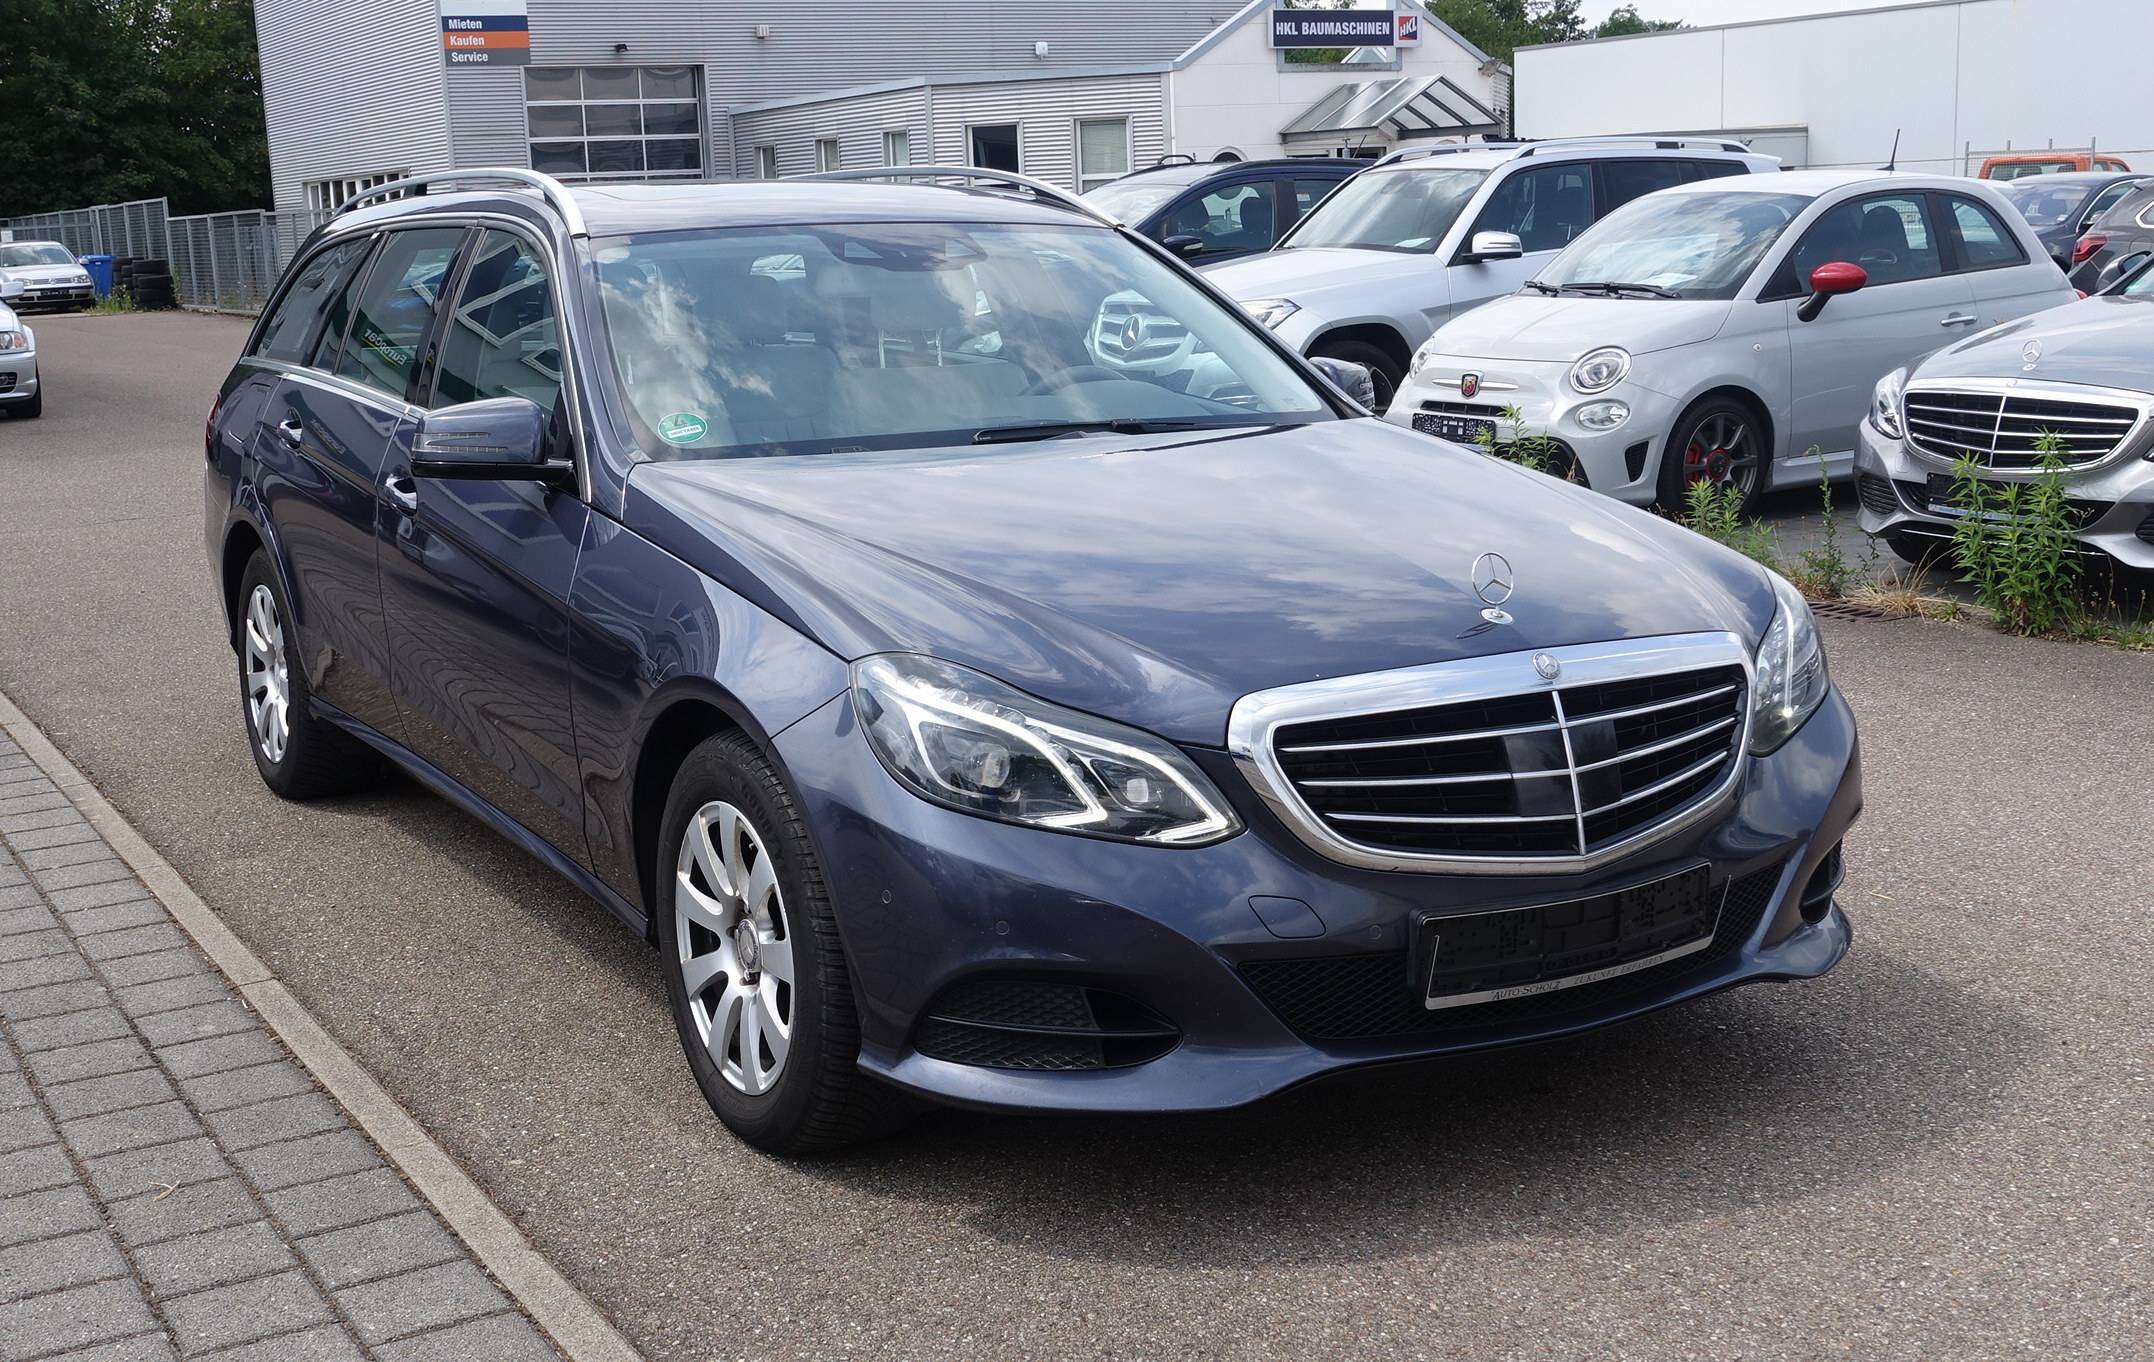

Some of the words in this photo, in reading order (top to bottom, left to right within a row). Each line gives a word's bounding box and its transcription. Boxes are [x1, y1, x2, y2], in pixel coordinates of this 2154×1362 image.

[448, 19, 482, 29] Mieten
[1276, 22, 1298, 35] HKL
[1302, 22, 1390, 35] BAUMASCHINEN
[1400, 17, 1417, 36] HKL
[450, 36, 485, 46] Kaufen
[451, 52, 488, 62] Service
